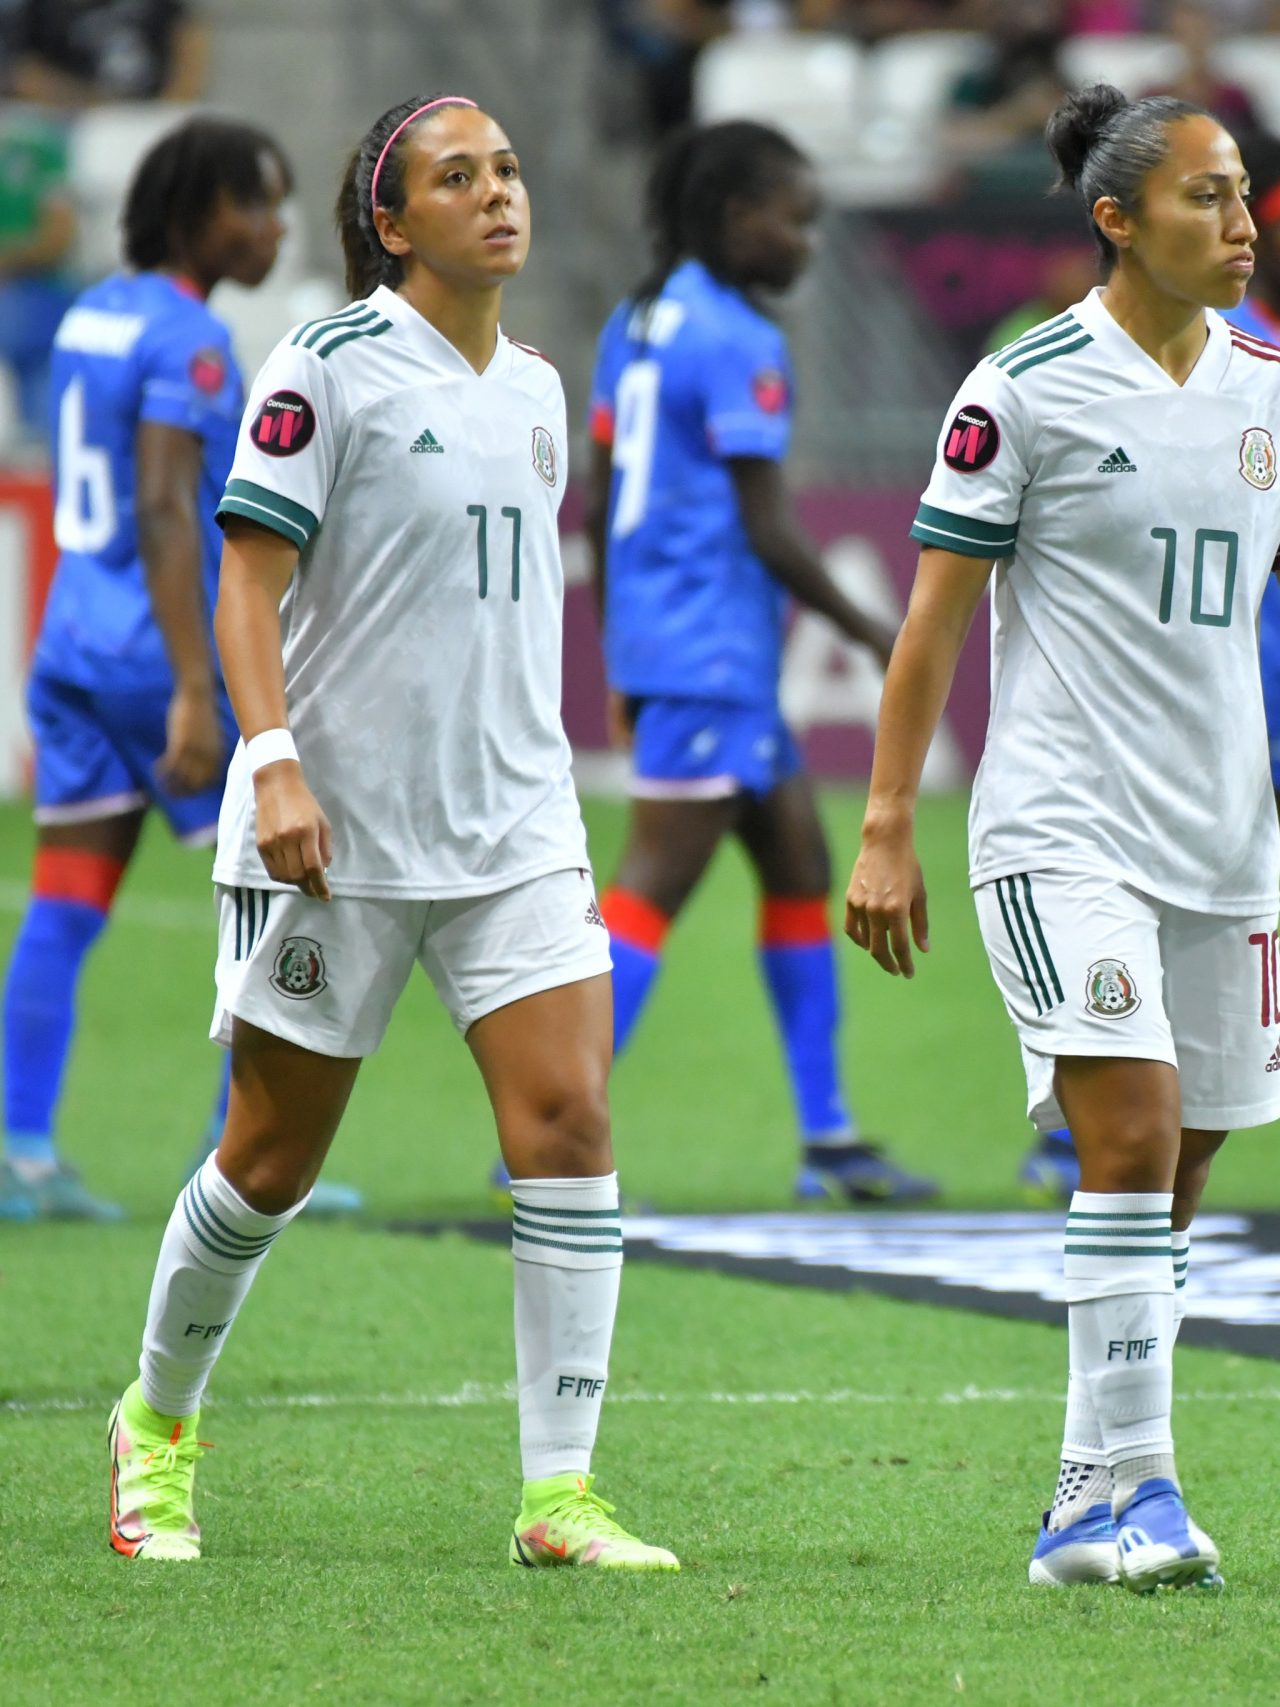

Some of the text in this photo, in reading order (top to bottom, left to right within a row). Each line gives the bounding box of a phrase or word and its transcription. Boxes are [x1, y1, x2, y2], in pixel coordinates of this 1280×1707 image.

[957, 411, 988, 428] Concacaf
[1097, 461, 1138, 473] adidas
[466, 504, 522, 602] 11
[1150, 526, 1239, 628] 10
[1107, 1337, 1158, 1361] FMF
[556, 1375, 605, 1399] FMF
